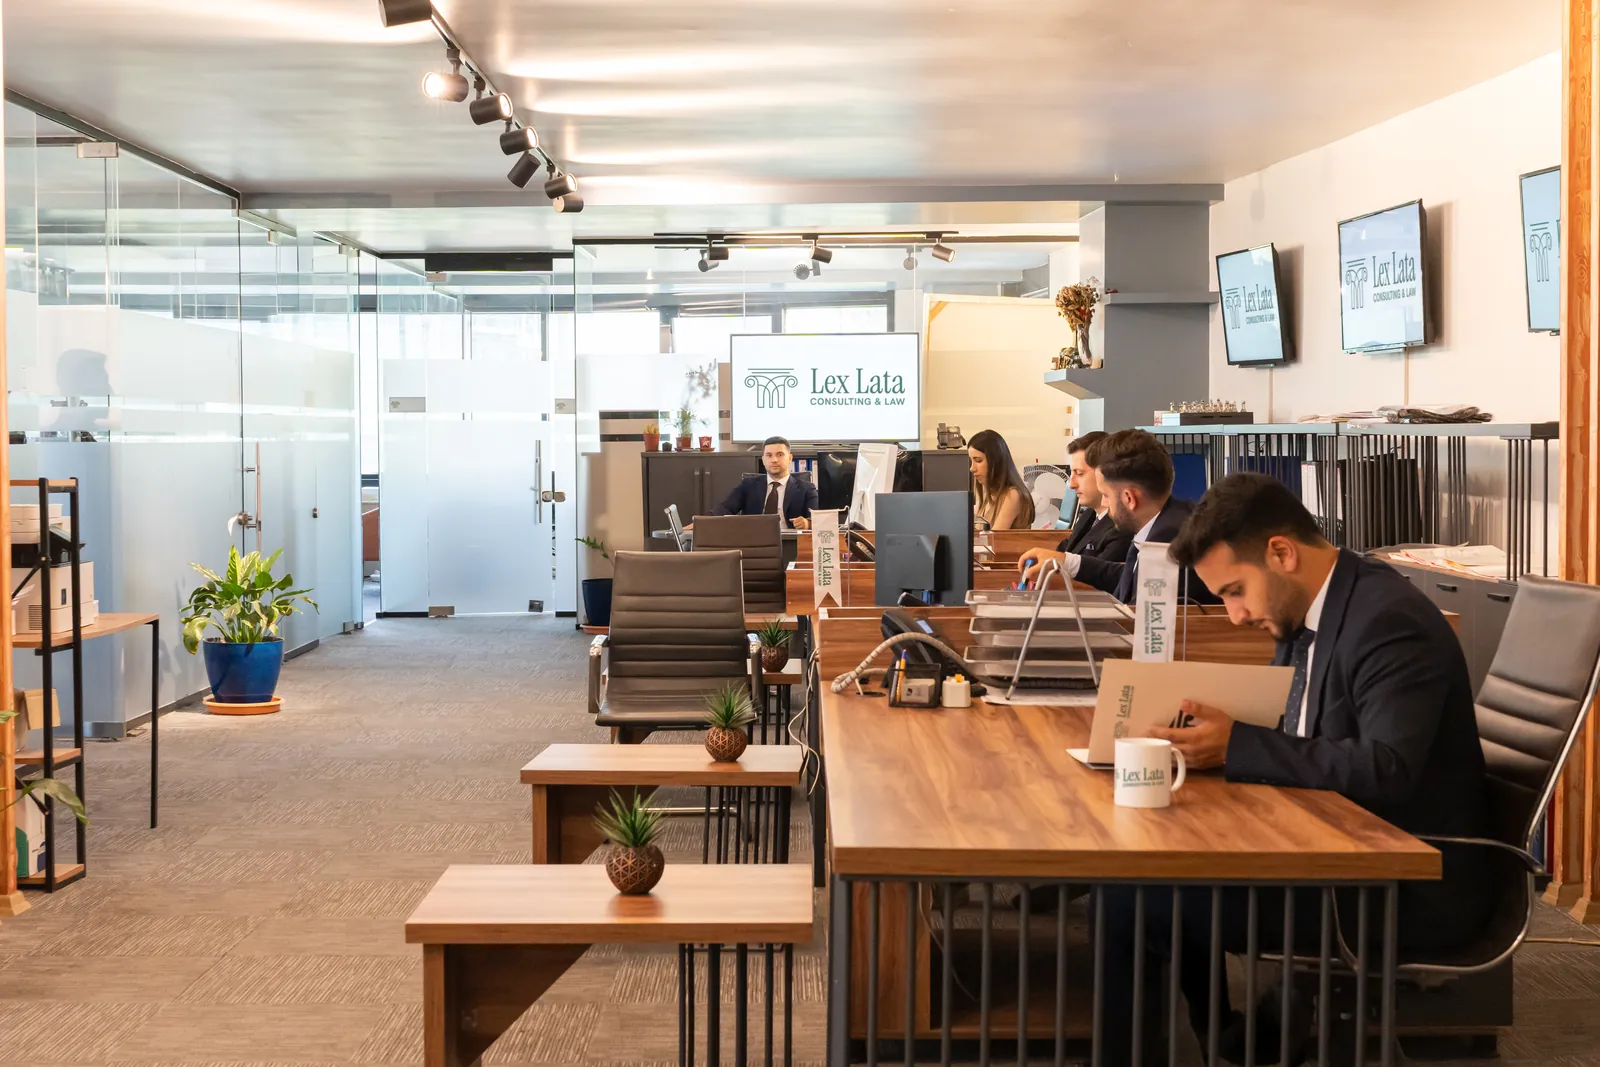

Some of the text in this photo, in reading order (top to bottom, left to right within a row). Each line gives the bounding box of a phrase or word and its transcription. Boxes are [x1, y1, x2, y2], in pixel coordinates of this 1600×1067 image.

[1372, 251, 1416, 288] Lex Lata
[1242, 284, 1273, 312] Lex Lata
[1373, 289, 1400, 303] CONSULTING
[1406, 286, 1416, 298] LAW
[810, 368, 906, 394] Lex Lata
[810, 397, 906, 406] CONSULTING & LAW
[823, 547, 834, 586] Lex Lata
[1151, 602, 1166, 654] Lex Lata
[1119, 685, 1131, 703] Lata
[1116, 704, 1127, 718] Lex
[1123, 767, 1165, 782] Lex Lata
